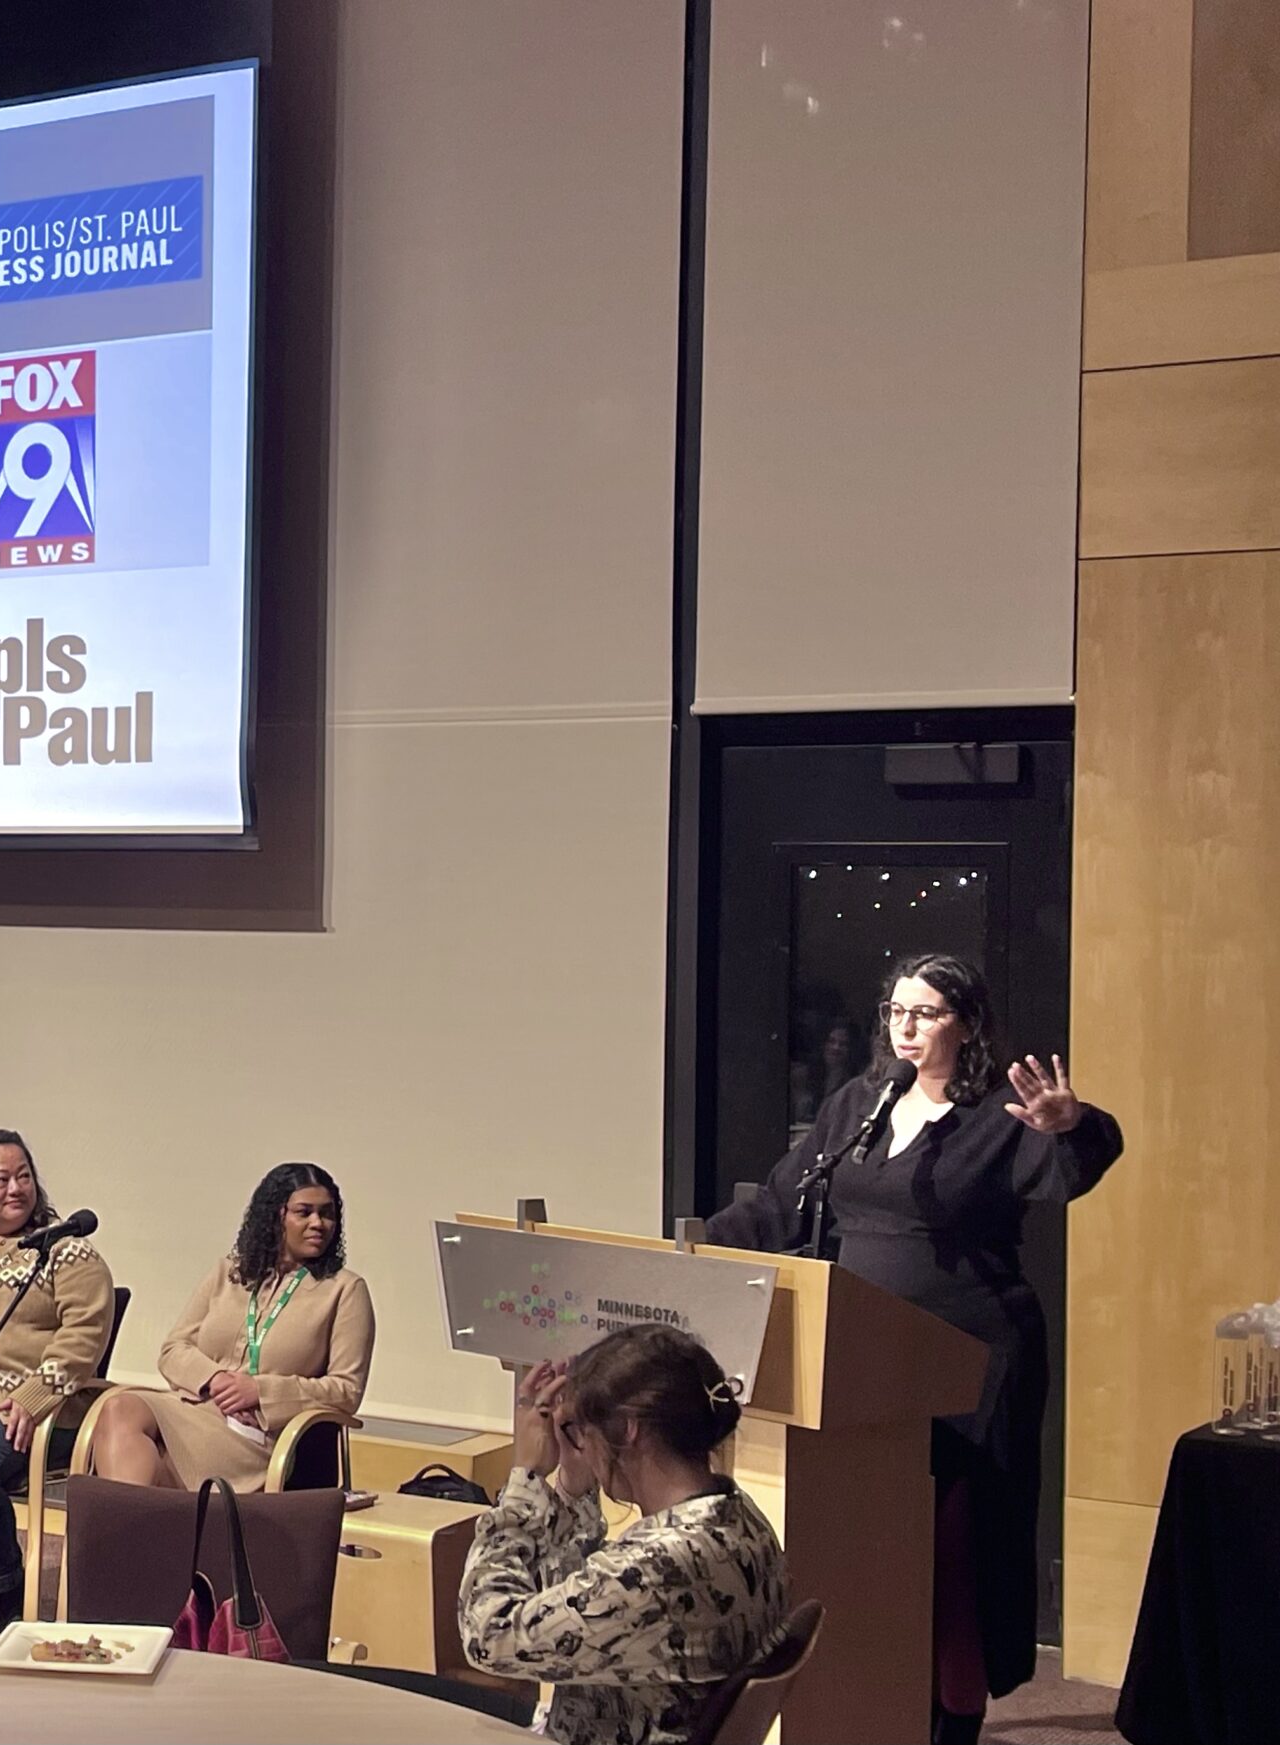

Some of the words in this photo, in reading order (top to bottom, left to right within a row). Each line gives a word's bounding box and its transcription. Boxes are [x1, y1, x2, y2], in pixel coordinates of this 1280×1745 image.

[121, 205, 182, 239] PAUL
[51, 239, 173, 280] JOURNAL
[3, 421, 71, 538] 9
[3, 691, 153, 766] Paul
[597, 1298, 680, 1324] MINNESOTA
